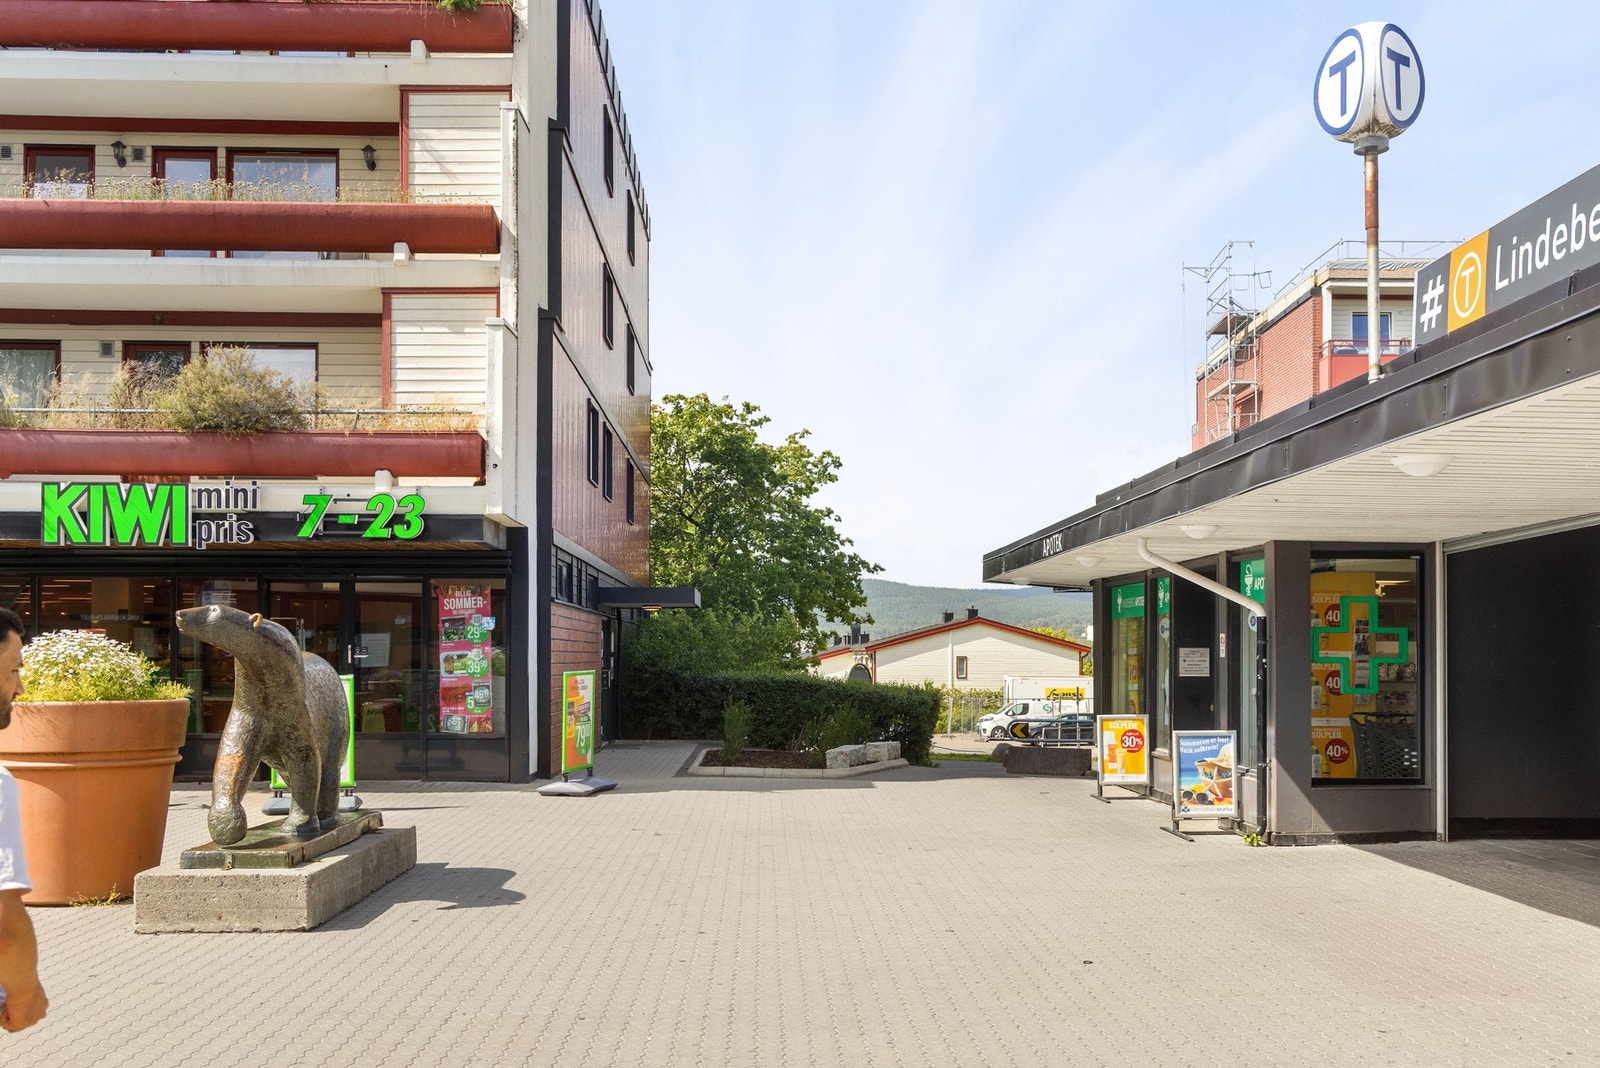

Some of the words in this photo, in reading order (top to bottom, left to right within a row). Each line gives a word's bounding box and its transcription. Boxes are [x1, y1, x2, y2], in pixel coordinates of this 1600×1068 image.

[1329, 50, 1356, 117] T
[1387, 46, 1410, 111] T
[196, 480, 258, 510] mini
[42, 482, 189, 546] KIWI
[196, 513, 254, 549] pris
[1043, 533, 1063, 557] APOTEK
[1254, 577, 1265, 590] APO
[444, 597, 487, 610] SOMMER-
[1108, 721, 1138, 729] SOLPLEIE
[1122, 736, 1143, 748] 30%
[1312, 731, 1343, 739] SOLPLEIE
[1326, 745, 1349, 758] 40%
